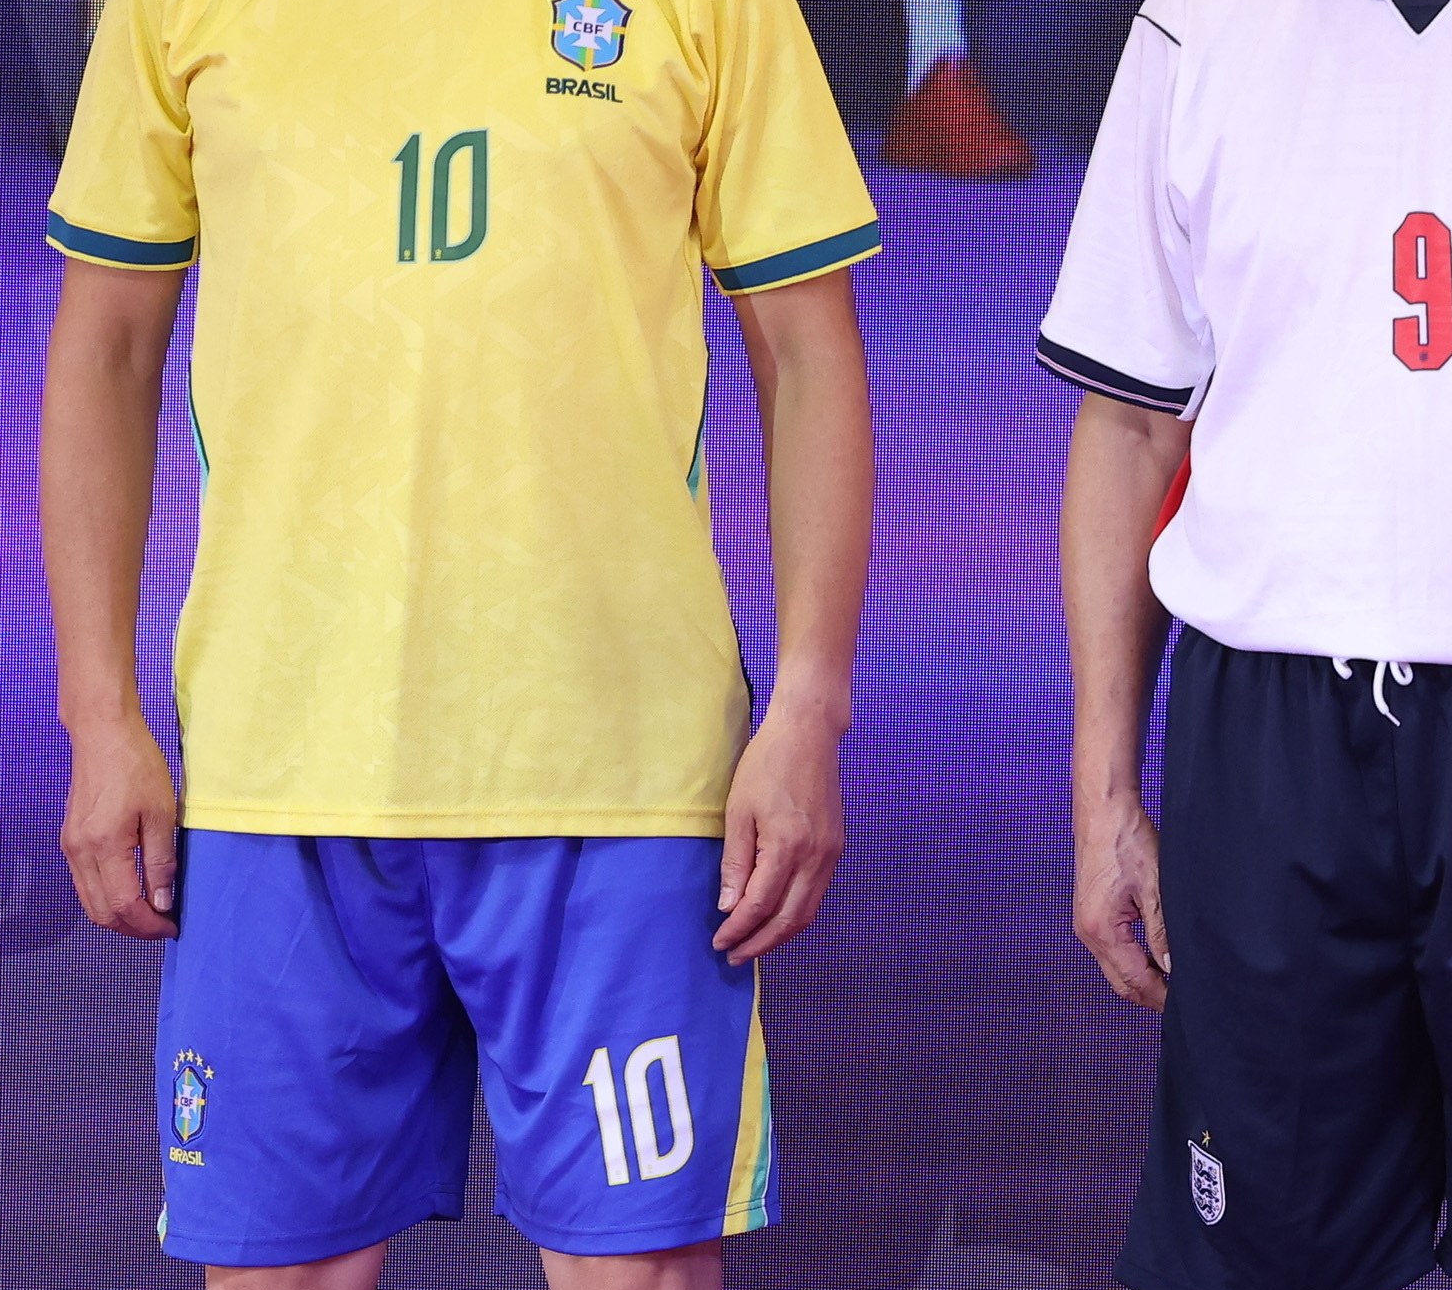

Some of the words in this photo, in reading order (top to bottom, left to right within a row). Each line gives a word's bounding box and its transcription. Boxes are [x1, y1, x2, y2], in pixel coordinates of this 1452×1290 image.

[573, 21, 604, 35] CBF
[546, 77, 623, 103] BRASIL
[390, 128, 490, 265] 10
[180, 1096, 194, 1108] CBF
[582, 1035, 695, 1187] 10
[169, 1147, 205, 1166] BRASIL
